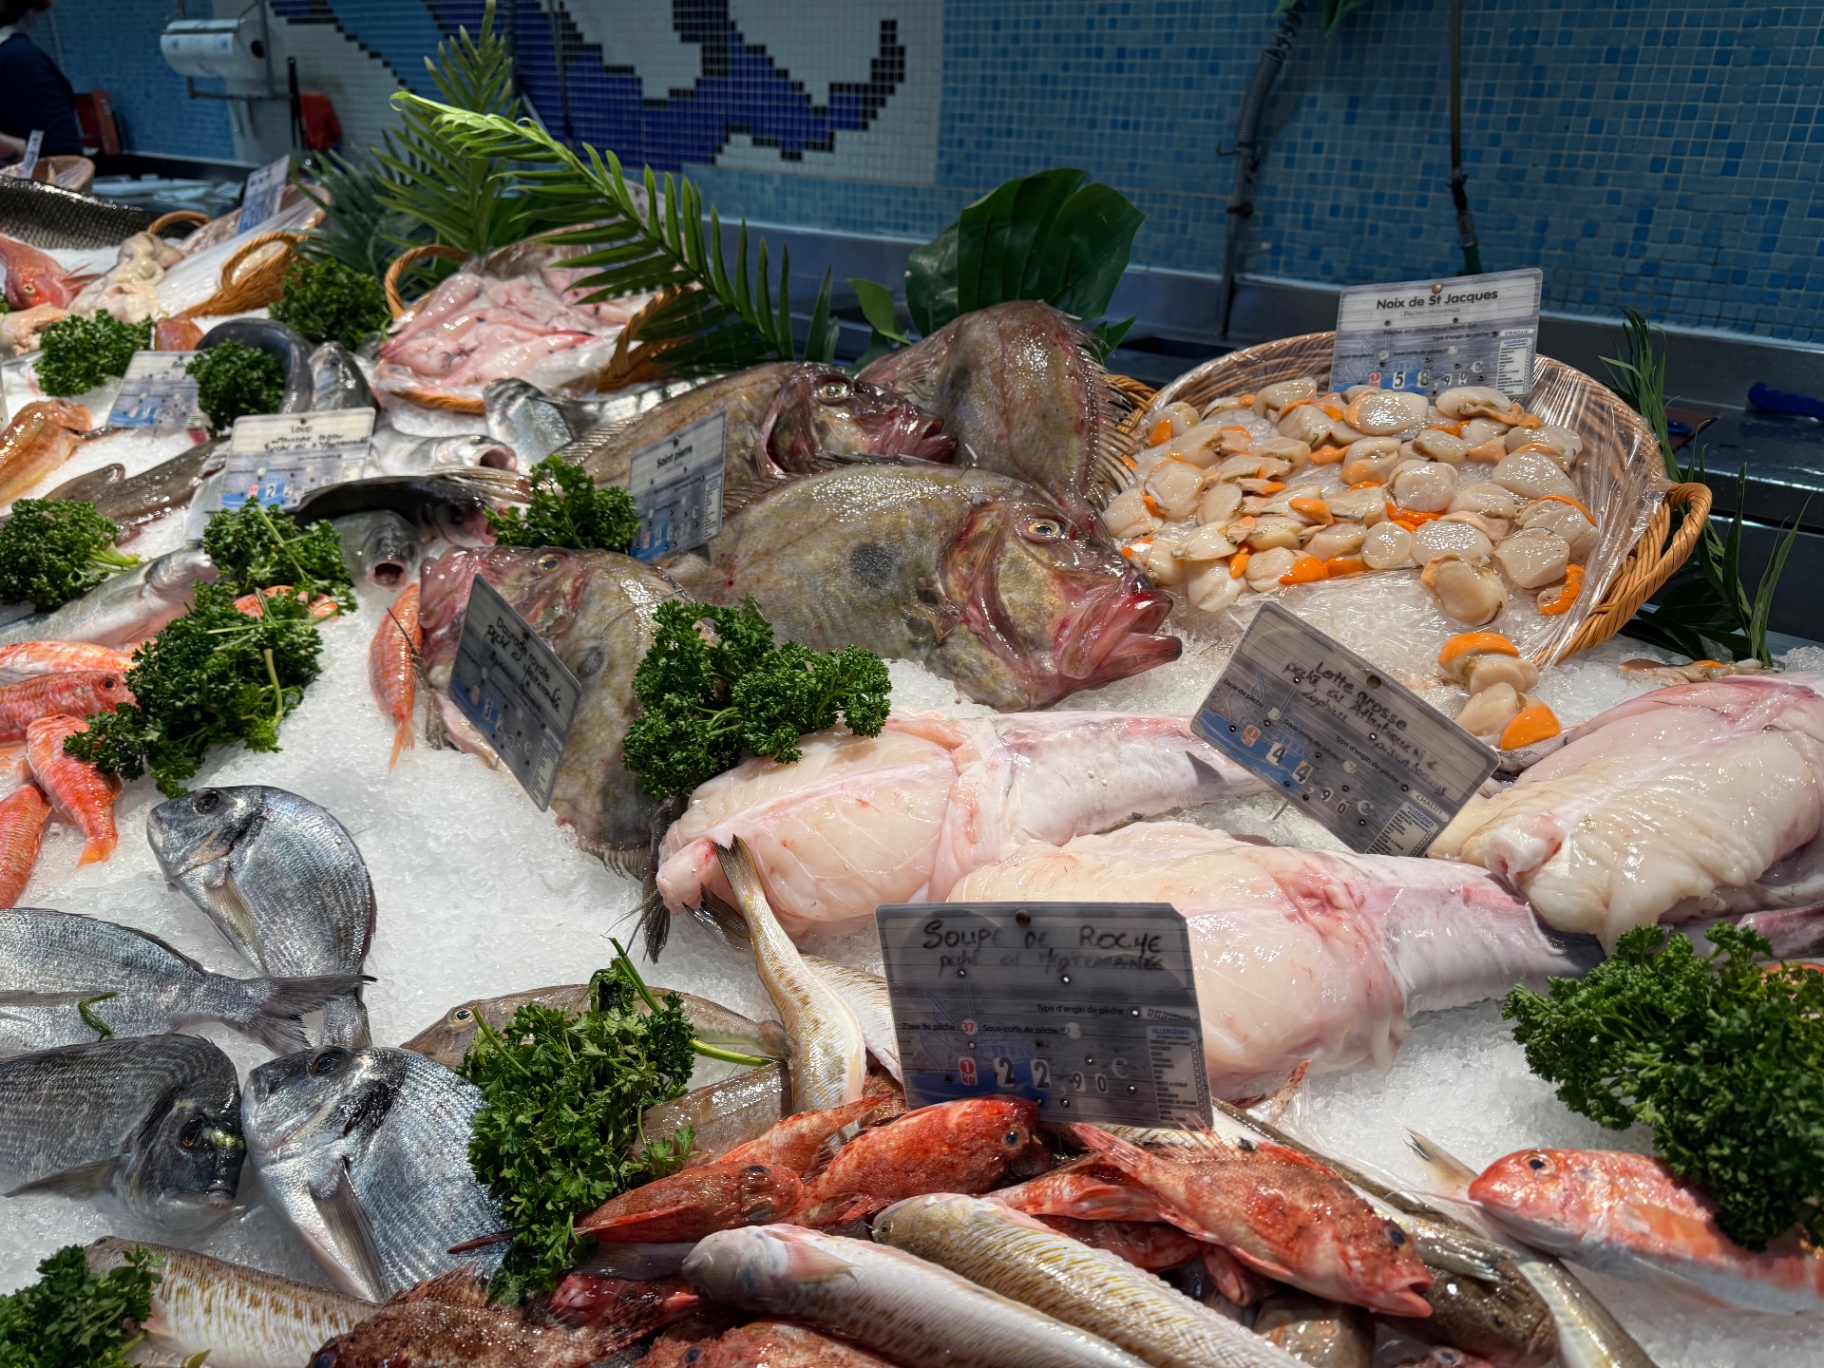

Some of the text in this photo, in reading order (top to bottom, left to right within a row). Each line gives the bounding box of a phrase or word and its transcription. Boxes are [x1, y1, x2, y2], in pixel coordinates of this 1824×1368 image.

[1376, 290, 1498, 310] Noix de St Jacques
[497, 616, 528, 656] Daurade
[529, 652, 550, 682] royale
[1316, 662, 1407, 732] Lotte grosse
[1336, 735, 1349, 748] Type
[1349, 746, 1372, 763] d'engin
[1371, 760, 1380, 770] de
[1357, 799, 1374, 816] €
[1416, 794, 1442, 814] CHALUT
[1036, 1004, 1124, 1017] Type d'engin de pêche
[902, 1022, 955, 1033] Zone de pêche
[962, 1022, 974, 1032] 37
[1023, 1025, 1034, 1034] de
[1111, 1058, 1130, 1079] €
[962, 1074, 975, 1085] kg
